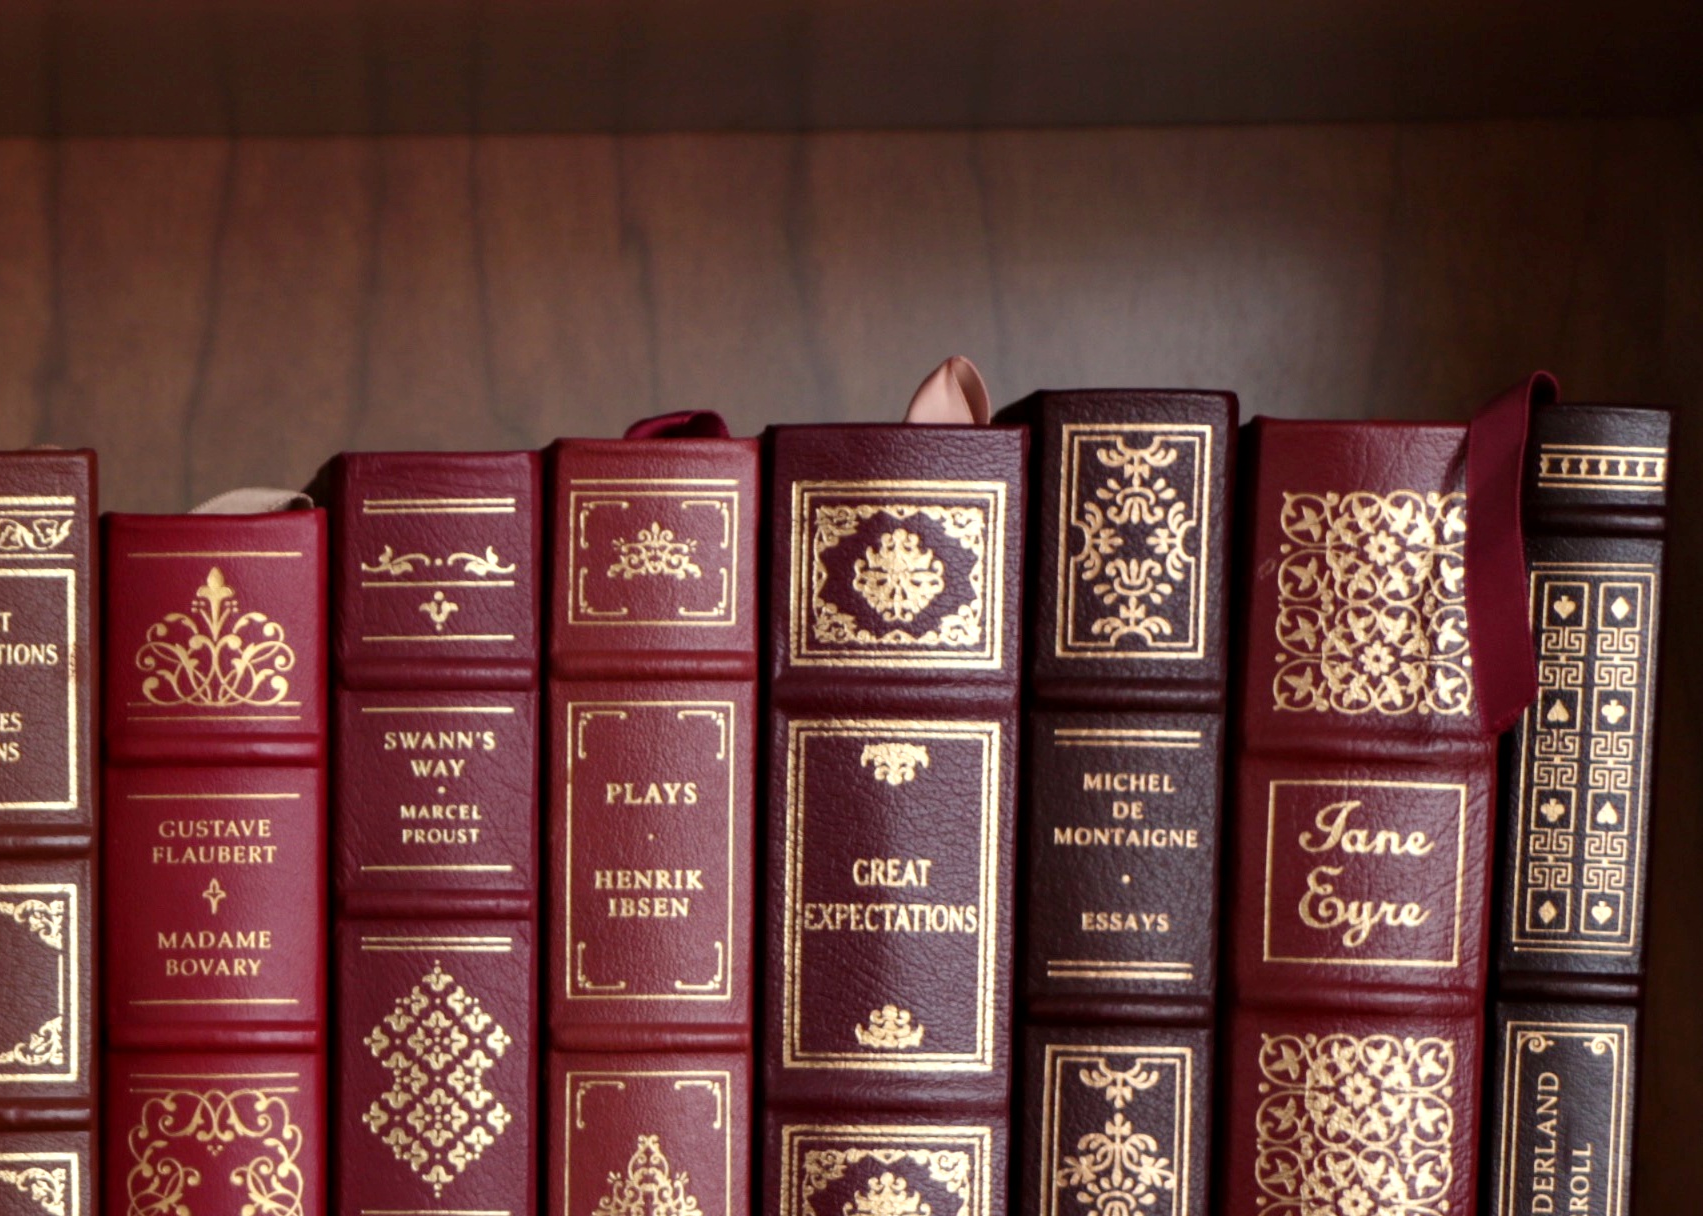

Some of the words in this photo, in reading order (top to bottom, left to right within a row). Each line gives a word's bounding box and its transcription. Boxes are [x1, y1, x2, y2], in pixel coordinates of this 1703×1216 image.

[383, 731, 497, 752] SWANN'S
[410, 759, 466, 778] WAY
[1083, 773, 1177, 793] MICHEL
[606, 782, 699, 806] PLAYS
[400, 805, 483, 821] MARCEL
[1112, 801, 1145, 820] DE
[158, 820, 273, 838] GUSTAVE
[401, 828, 481, 845] PROUST
[1053, 827, 1200, 849] MONTAIGNE
[1298, 800, 1436, 856] Jane
[152, 845, 278, 864] FLAUBERT
[595, 869, 705, 891] HENRIK
[852, 858, 932, 888] GREAT
[607, 897, 691, 918] IBSEN
[1298, 865, 1433, 948] Eyre
[804, 904, 979, 934] EXPECTATIONS
[1081, 913, 1171, 933] ESSAYS
[157, 931, 273, 949] MADAME
[165, 958, 263, 977] BOVARY
